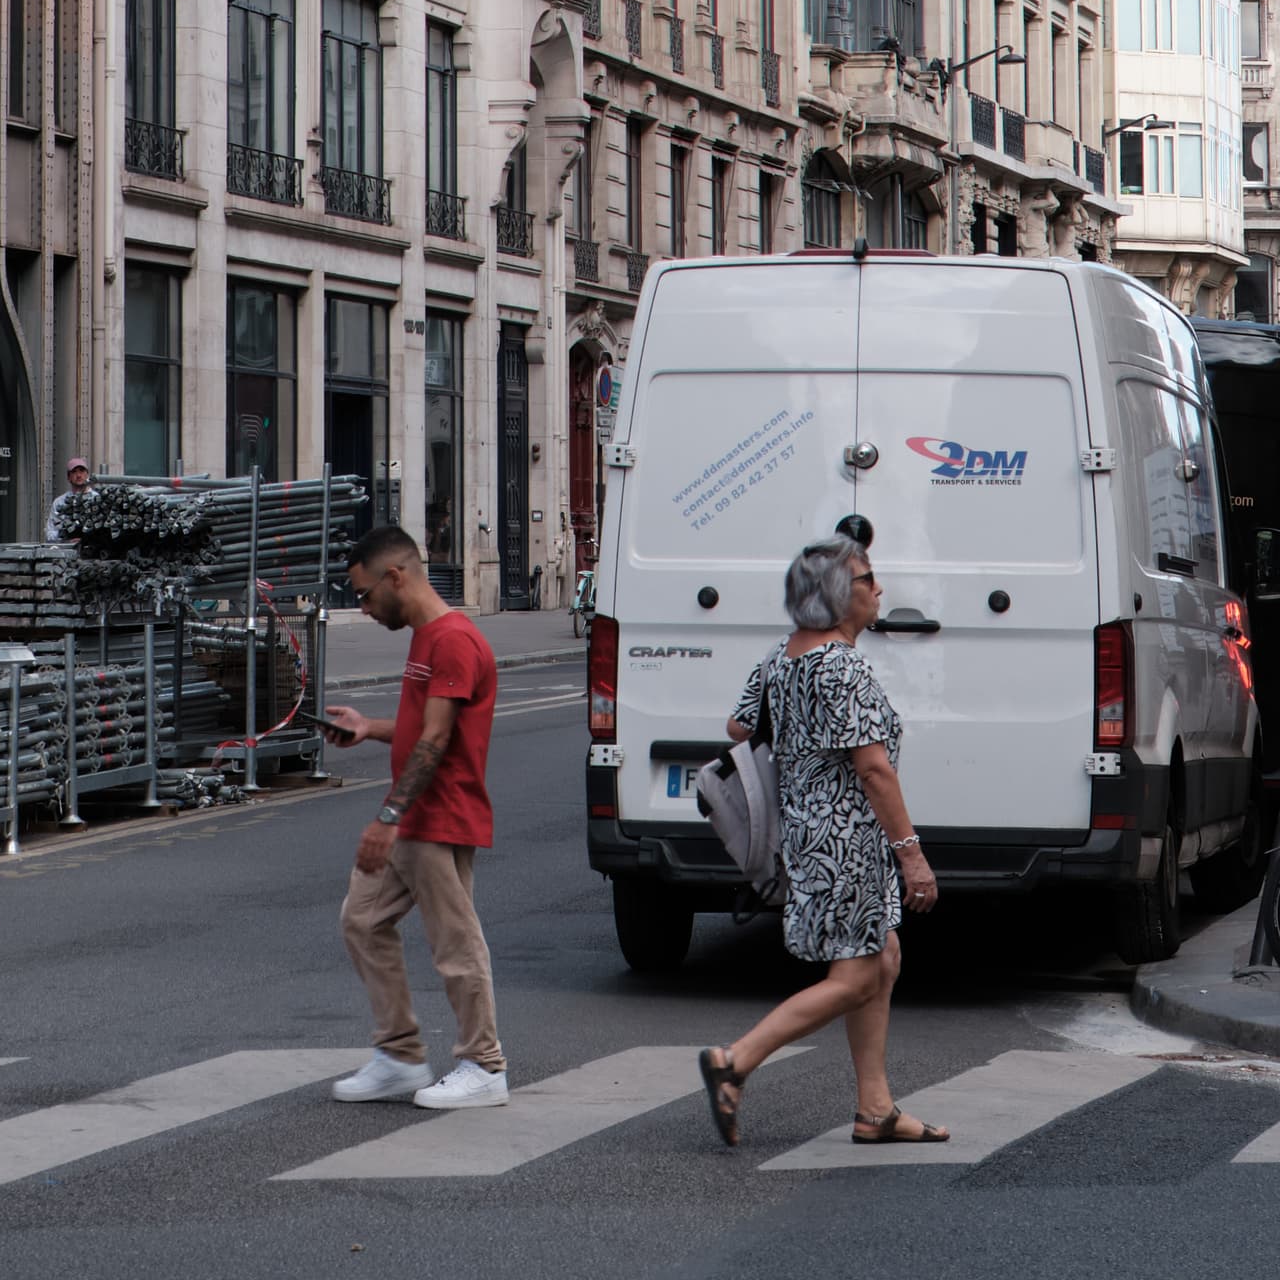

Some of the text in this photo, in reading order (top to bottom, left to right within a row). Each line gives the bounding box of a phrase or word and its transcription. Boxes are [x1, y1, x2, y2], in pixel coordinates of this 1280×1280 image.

[672, 409, 789, 504] www.ddmasters.com
[682, 410, 814, 517] contact@ddmasters.info
[715, 497, 731, 513] 09
[731, 483, 748, 500] 82
[748, 471, 765, 486] 42
[764, 457, 779, 474] 37
[780, 444, 796, 461] 57
[931, 441, 1028, 479] 2DM
[628, 646, 713, 659] CRAFTER
